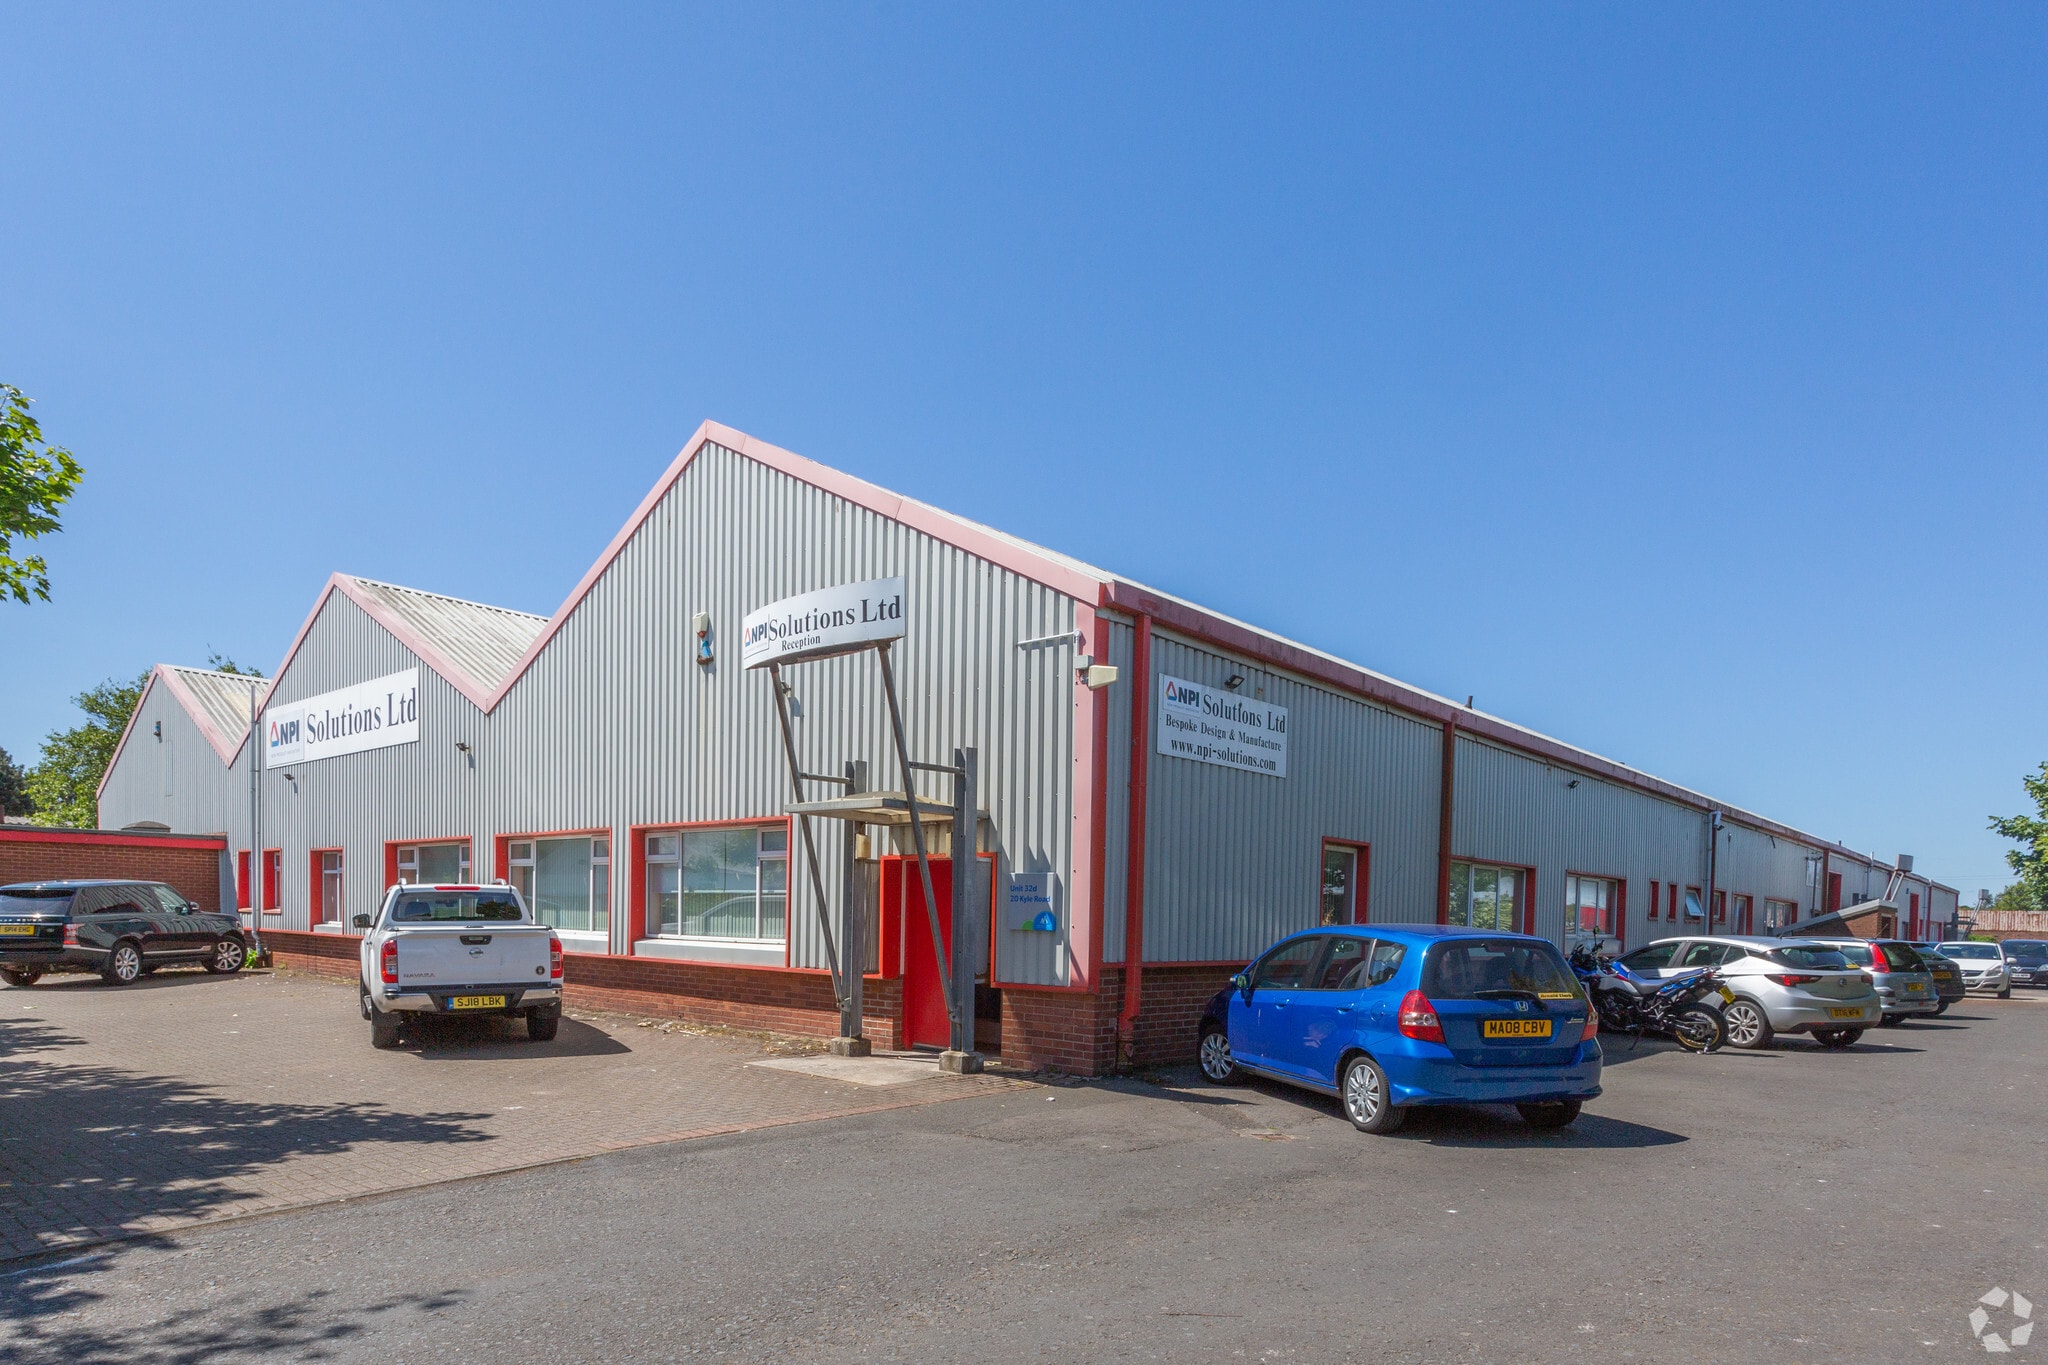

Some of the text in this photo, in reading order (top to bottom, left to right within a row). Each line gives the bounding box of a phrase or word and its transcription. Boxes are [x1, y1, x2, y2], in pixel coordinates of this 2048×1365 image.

[751, 595, 902, 644] NPI Solutions Ltd
[781, 634, 821, 651] Reception
[280, 687, 417, 746] NPI Solutions Ltd
[1178, 686, 1200, 708] NPI
[1203, 694, 1262, 727] Solutions
[1267, 710, 1286, 733] Ltd
[1166, 714, 1282, 751] Bespoke Design & Manufacture
[1171, 739, 1276, 771] www.npi-solutions.com
[1010, 884, 1038, 892] Unit 32d
[1020, 895, 1033, 904] Kyle
[1033, 895, 1051, 903] Road
[457, 997, 502, 1007] SJ18 LBK
[1489, 1021, 1546, 1034] MA08 CBV
